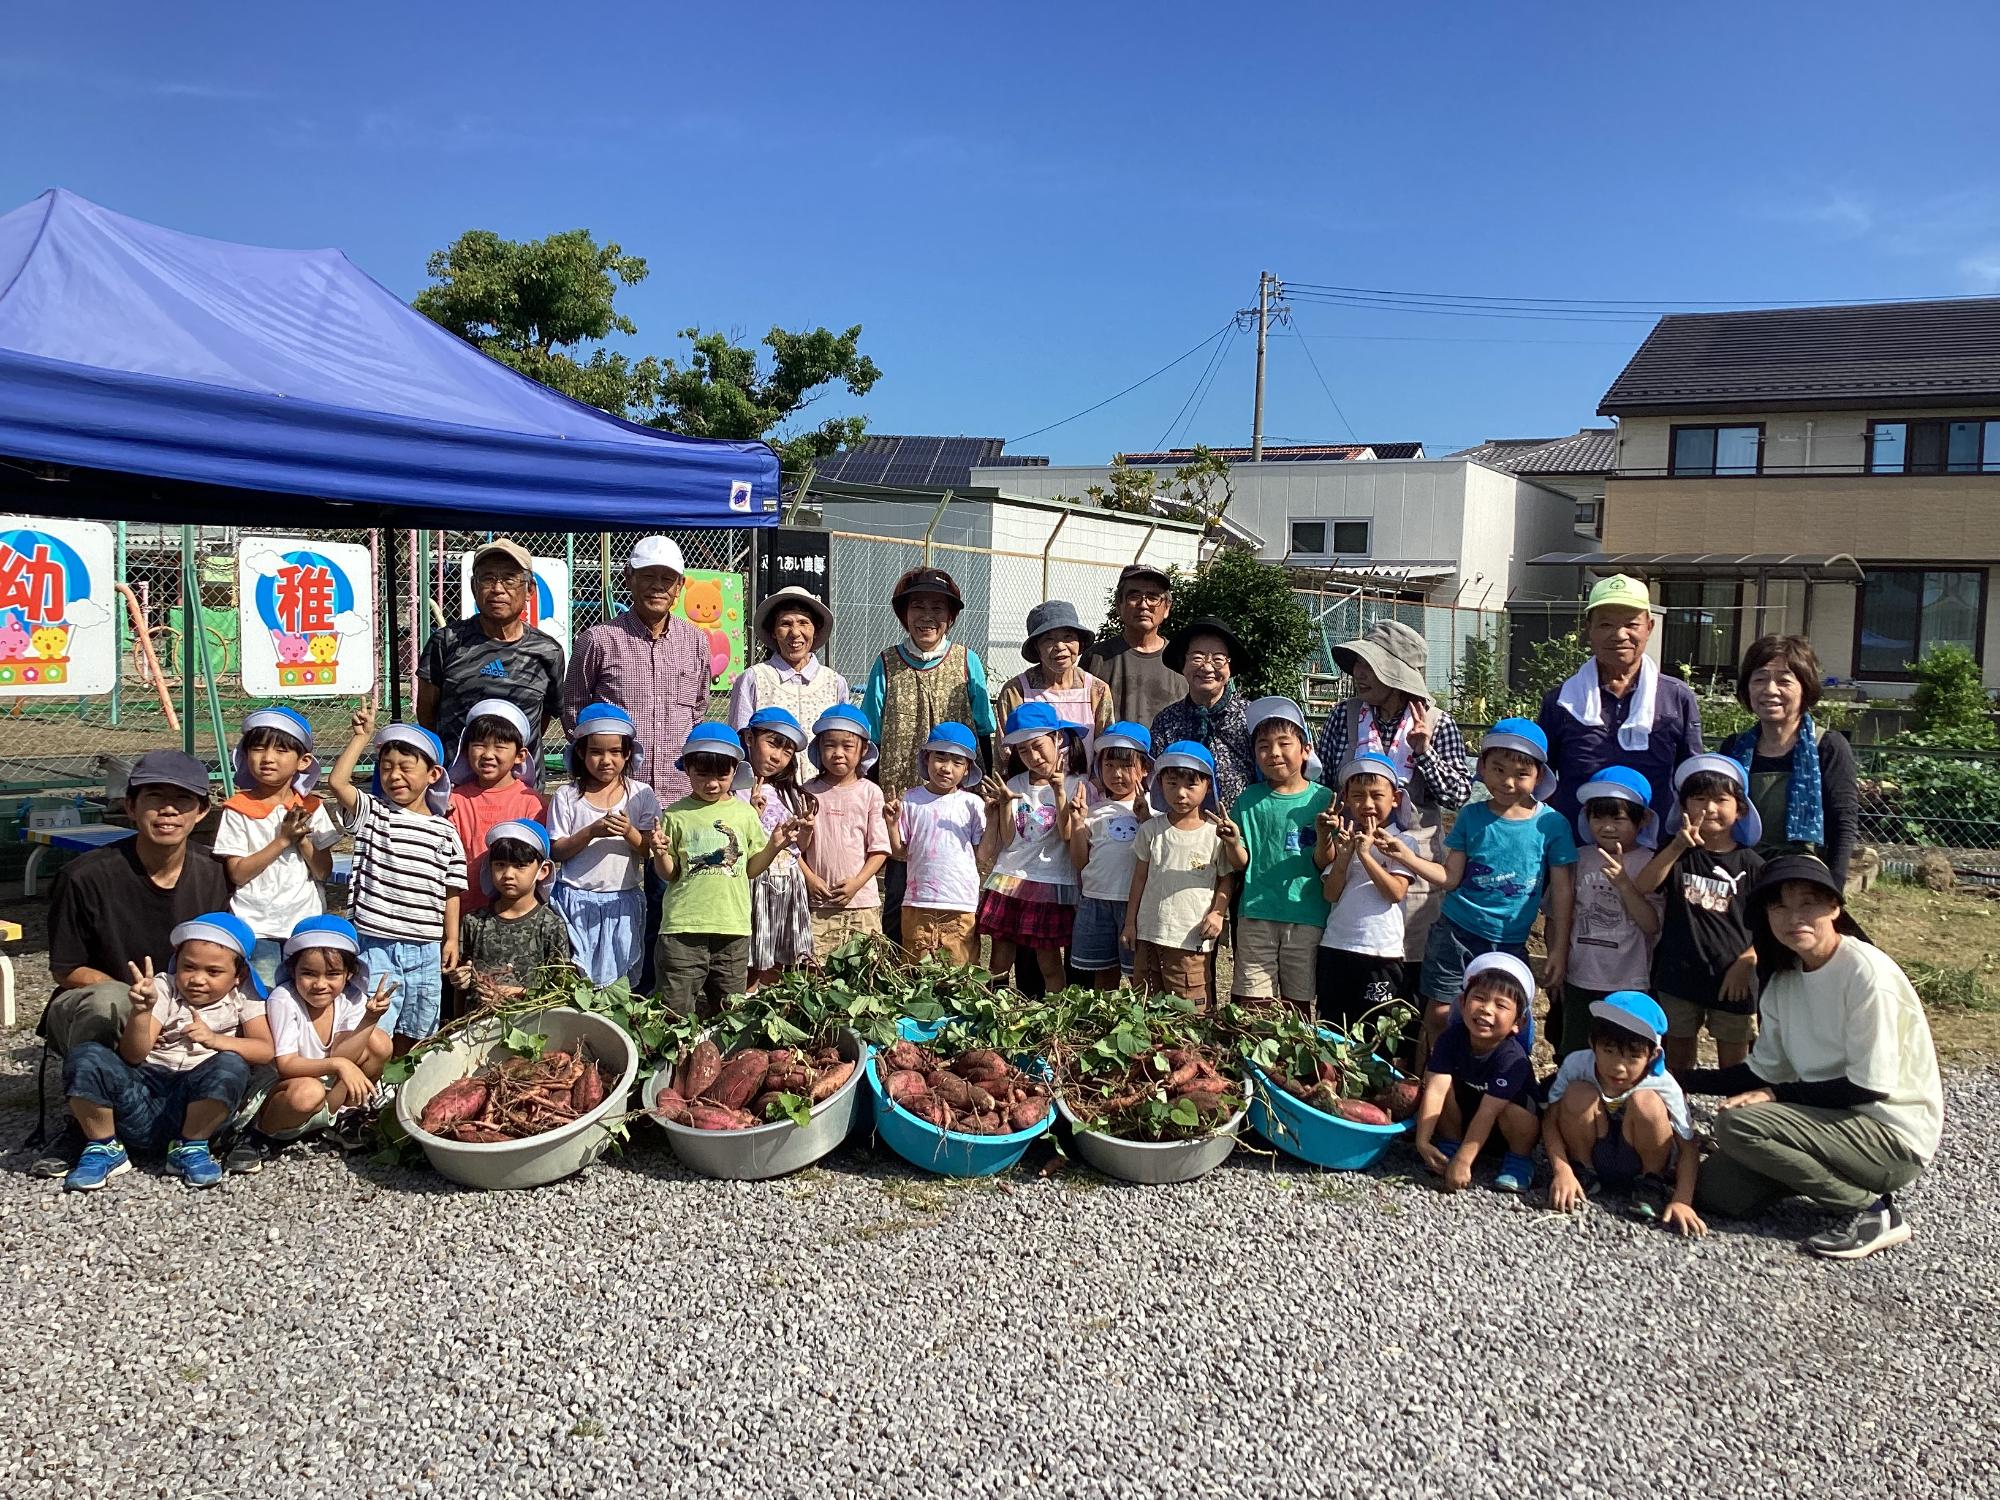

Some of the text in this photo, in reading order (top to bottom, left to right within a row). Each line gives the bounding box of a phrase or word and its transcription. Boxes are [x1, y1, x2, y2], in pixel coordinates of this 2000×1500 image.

[0, 543, 65, 623] 幼
[276, 565, 335, 633] 稚
[480, 668, 509, 678] adidas
